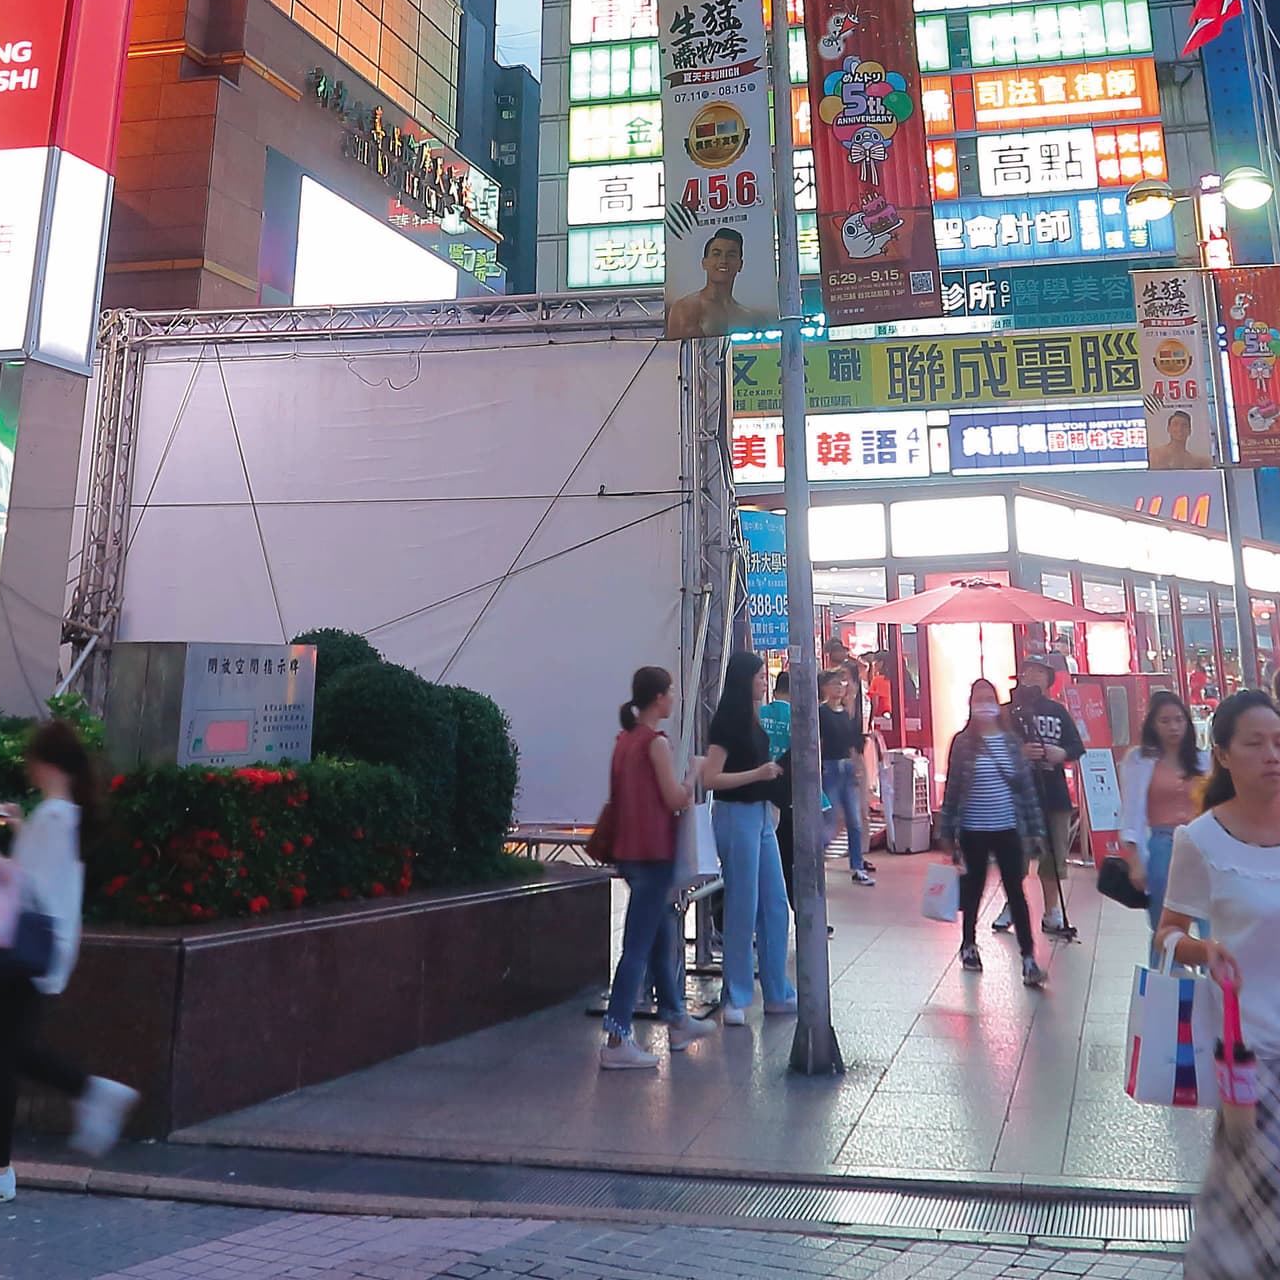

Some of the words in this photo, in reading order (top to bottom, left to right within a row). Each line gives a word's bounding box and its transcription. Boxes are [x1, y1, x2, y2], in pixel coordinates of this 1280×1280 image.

[842, 83, 886, 117] 5th
[837, 116, 893, 125] ANNIVERSARY
[991, 141, 1084, 186] 高點
[1013, 273, 1130, 307] 醫學美容
[1142, 278, 1187, 305] 生猛
[887, 332, 1143, 403] 聯成電腦
